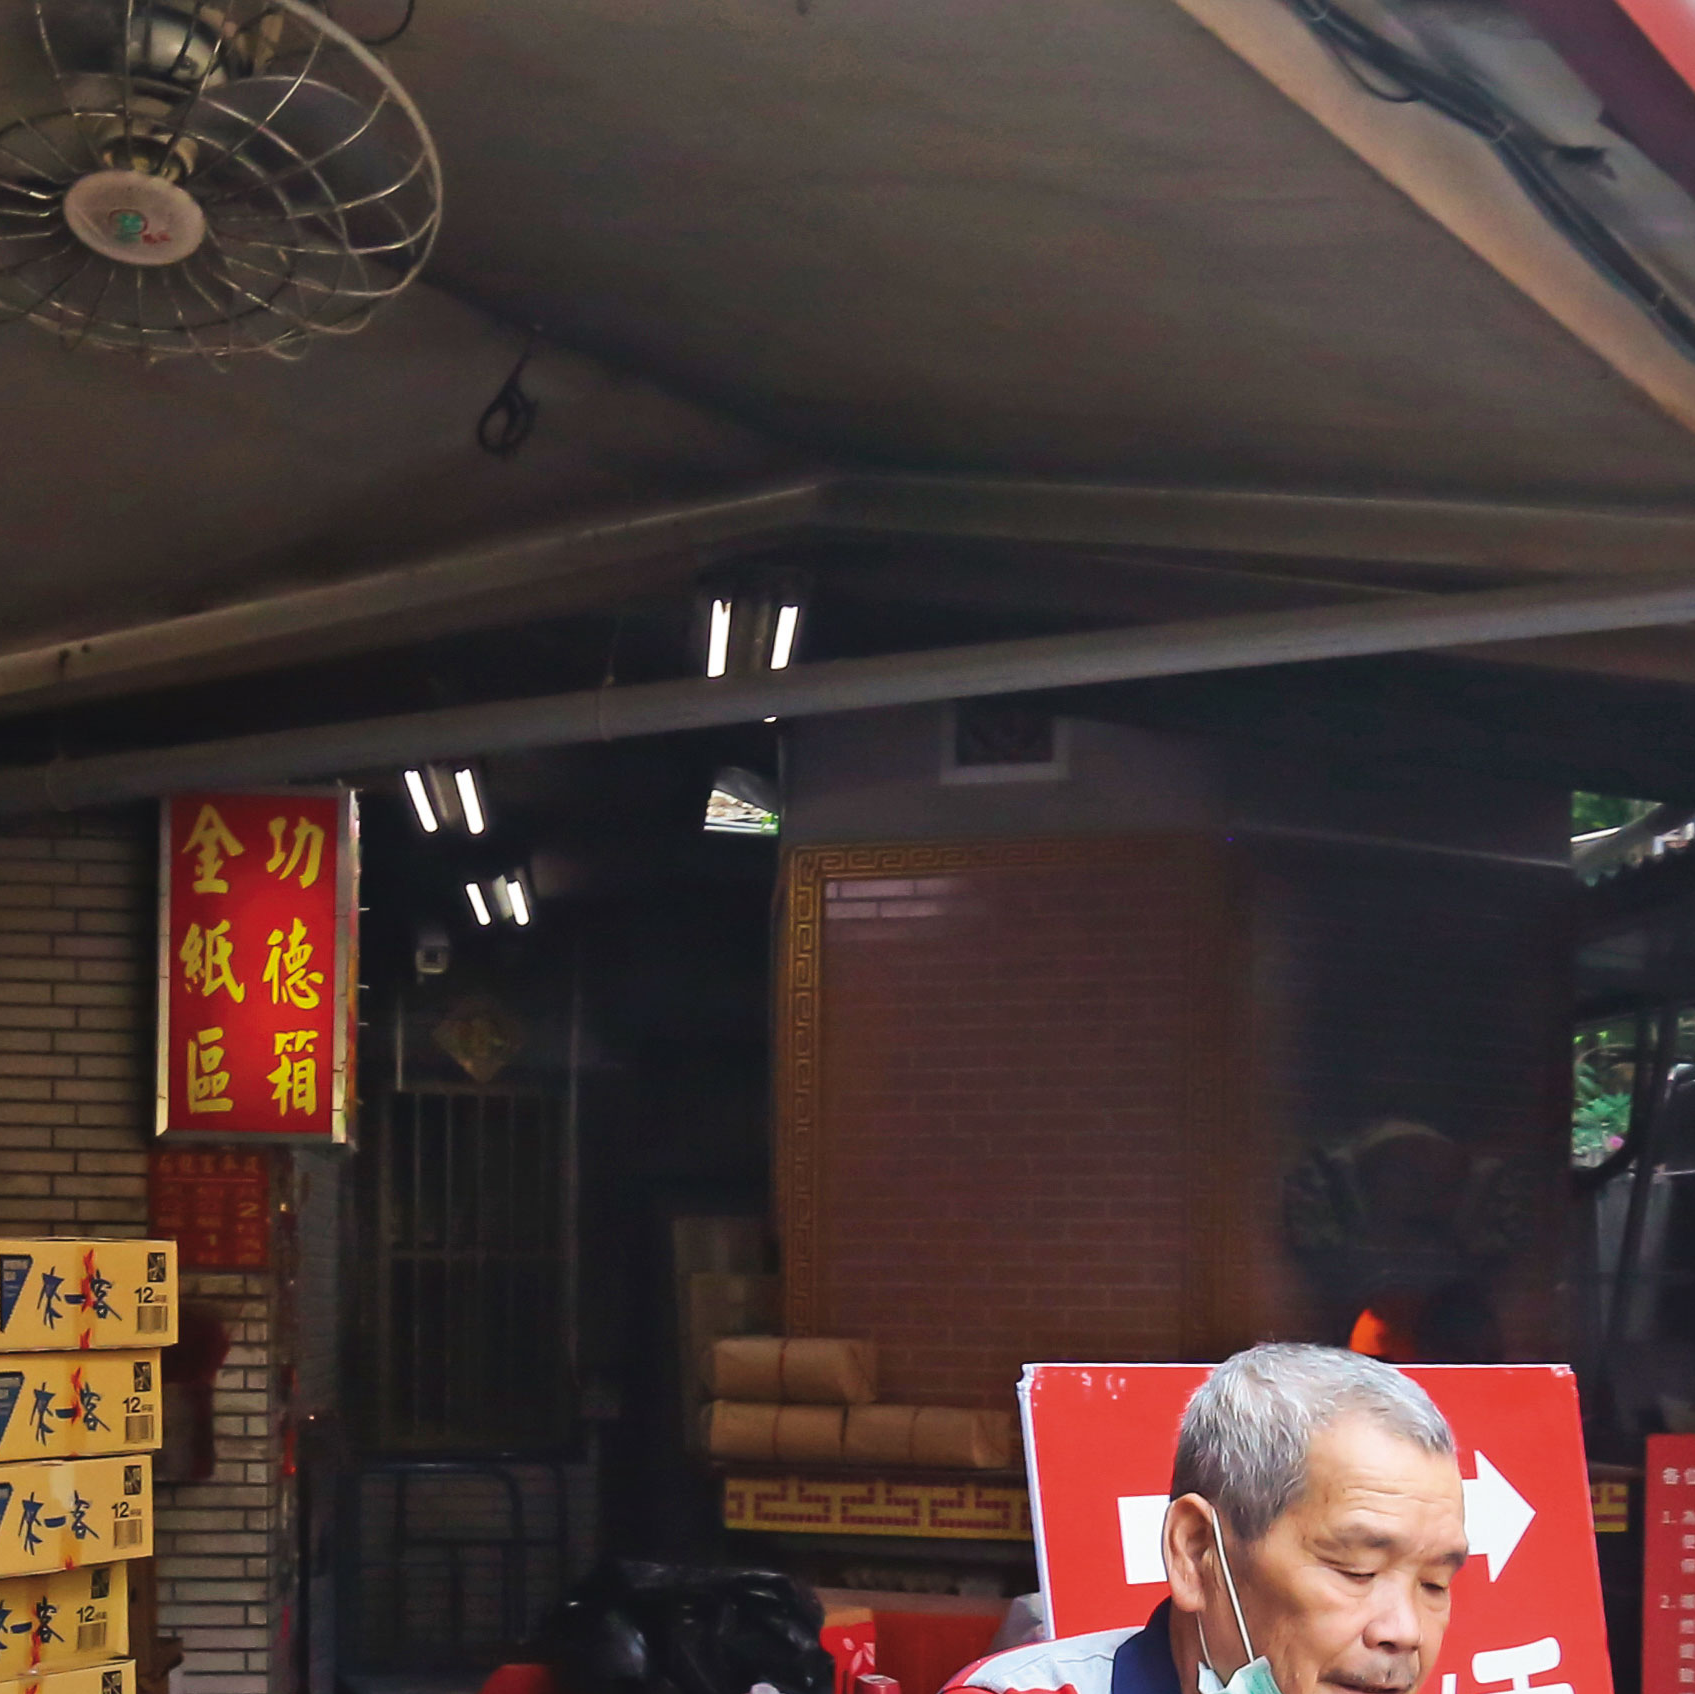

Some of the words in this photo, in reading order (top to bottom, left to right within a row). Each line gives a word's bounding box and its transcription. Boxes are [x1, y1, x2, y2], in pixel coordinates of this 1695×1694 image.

[179, 803, 246, 1115] 金紙區
[263, 815, 325, 1117] 功德箱
[36, 1265, 123, 1330] 來一客
[29, 1381, 111, 1447] 來一客
[17, 1490, 100, 1557] 來一客
